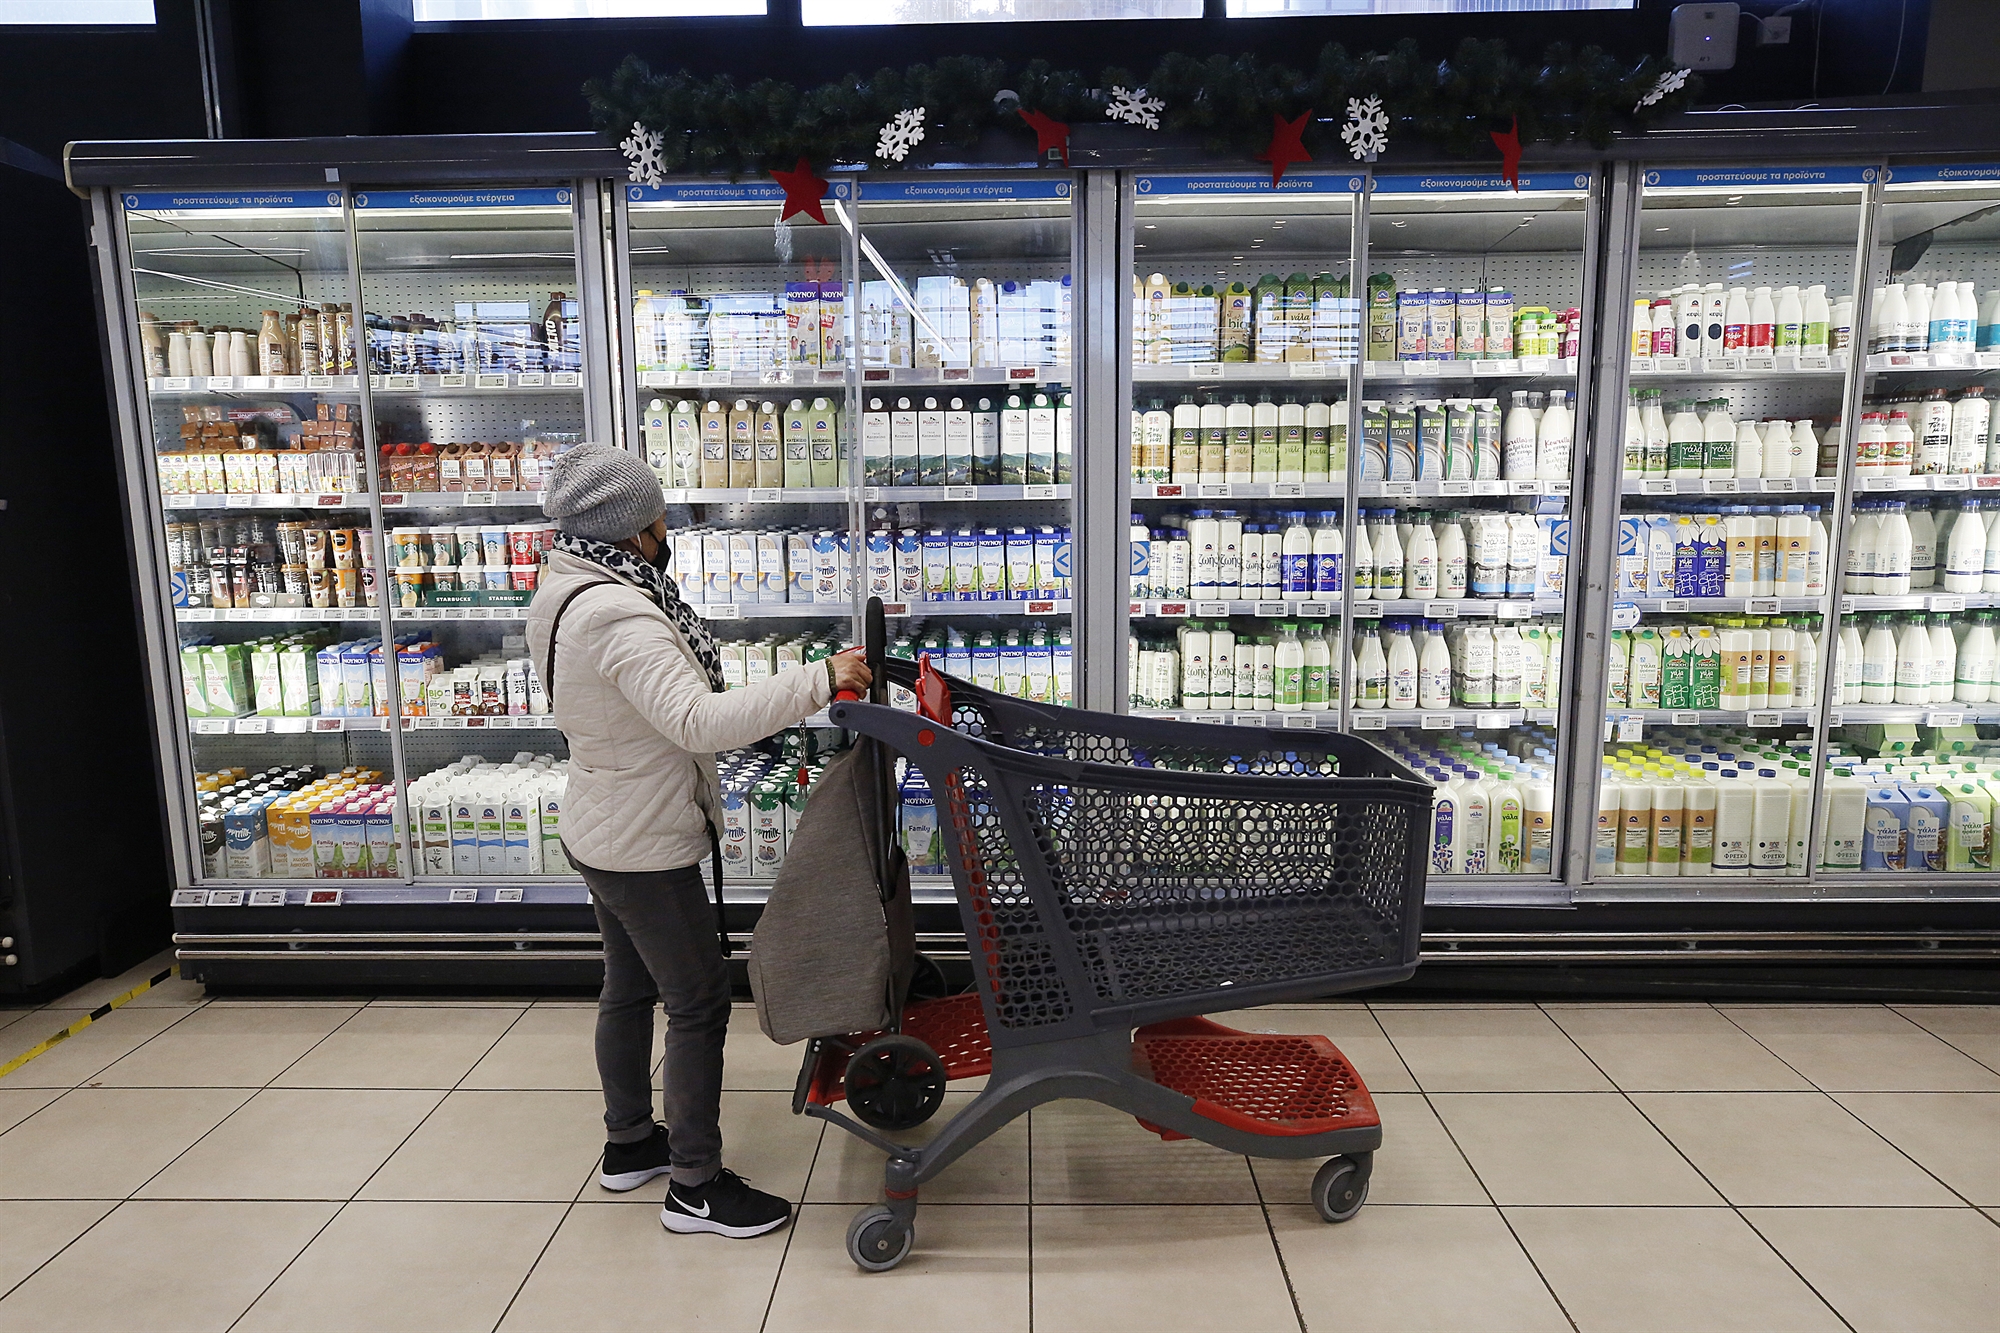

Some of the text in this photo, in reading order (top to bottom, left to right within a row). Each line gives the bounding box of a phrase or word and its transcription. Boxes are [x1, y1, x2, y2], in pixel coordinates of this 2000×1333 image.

[1420, 177, 1531, 188] εξοικονομούμε ενέρεια
[1696, 170, 1826, 183] προστατεύουμε τα προϊόντα
[904, 184, 1012, 196] εξοικονομούμε ενέργεια
[1187, 178, 1313, 190] προστατεύουμε τα ροϊόντα
[677, 187, 745, 198] προστατεύουμε
[759, 186, 786, 197] προϊό
[173, 195, 239, 206] προστατεύουμε
[254, 194, 294, 205] προϊόντα
[409, 192, 515, 205] εξοικονομούμε ενέργεια
[909, 825, 932, 833] Family
